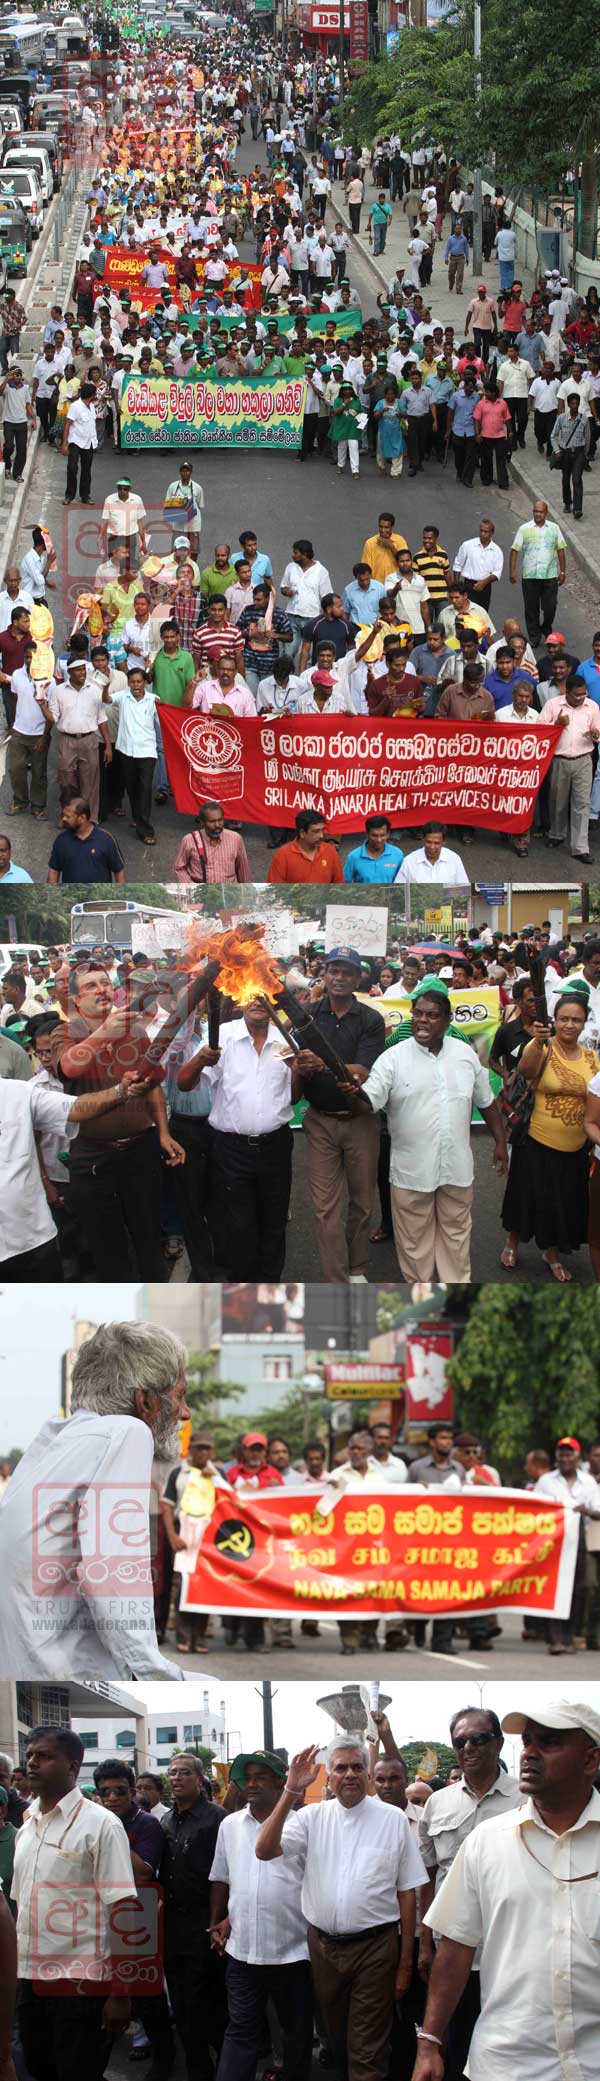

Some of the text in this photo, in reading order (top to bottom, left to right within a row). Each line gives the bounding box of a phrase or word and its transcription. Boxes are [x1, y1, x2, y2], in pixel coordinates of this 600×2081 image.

[169, 383, 195, 423] විදුලි
[196, 383, 215, 422] බිල
[217, 386, 240, 416] වහා
[150, 427, 171, 443] සේවා
[173, 428, 200, 443] ජාතික
[279, 734, 326, 758] ලංකා
[328, 731, 384, 759] ජනරජ
[437, 733, 481, 758] සේවා
[483, 734, 551, 760] සංගමය
[281, 762, 322, 788] லங்கா
[498, 765, 540, 789] சங்கம்
[264, 787, 283, 807] SRI
[284, 788, 326, 815] LANKA
[326, 793, 378, 820] JANARJA
[430, 789, 490, 810] SERVICES
[492, 794, 533, 815] UNION
[344, 1503, 386, 1536] සම
[393, 1503, 465, 1536] සමාජ
[404, 1546, 479, 1570] சமாஜ
[294, 1580, 348, 1600] NAVA
[410, 1579, 486, 1600] SAMAJA
[490, 1575, 549, 1597] PARTY
